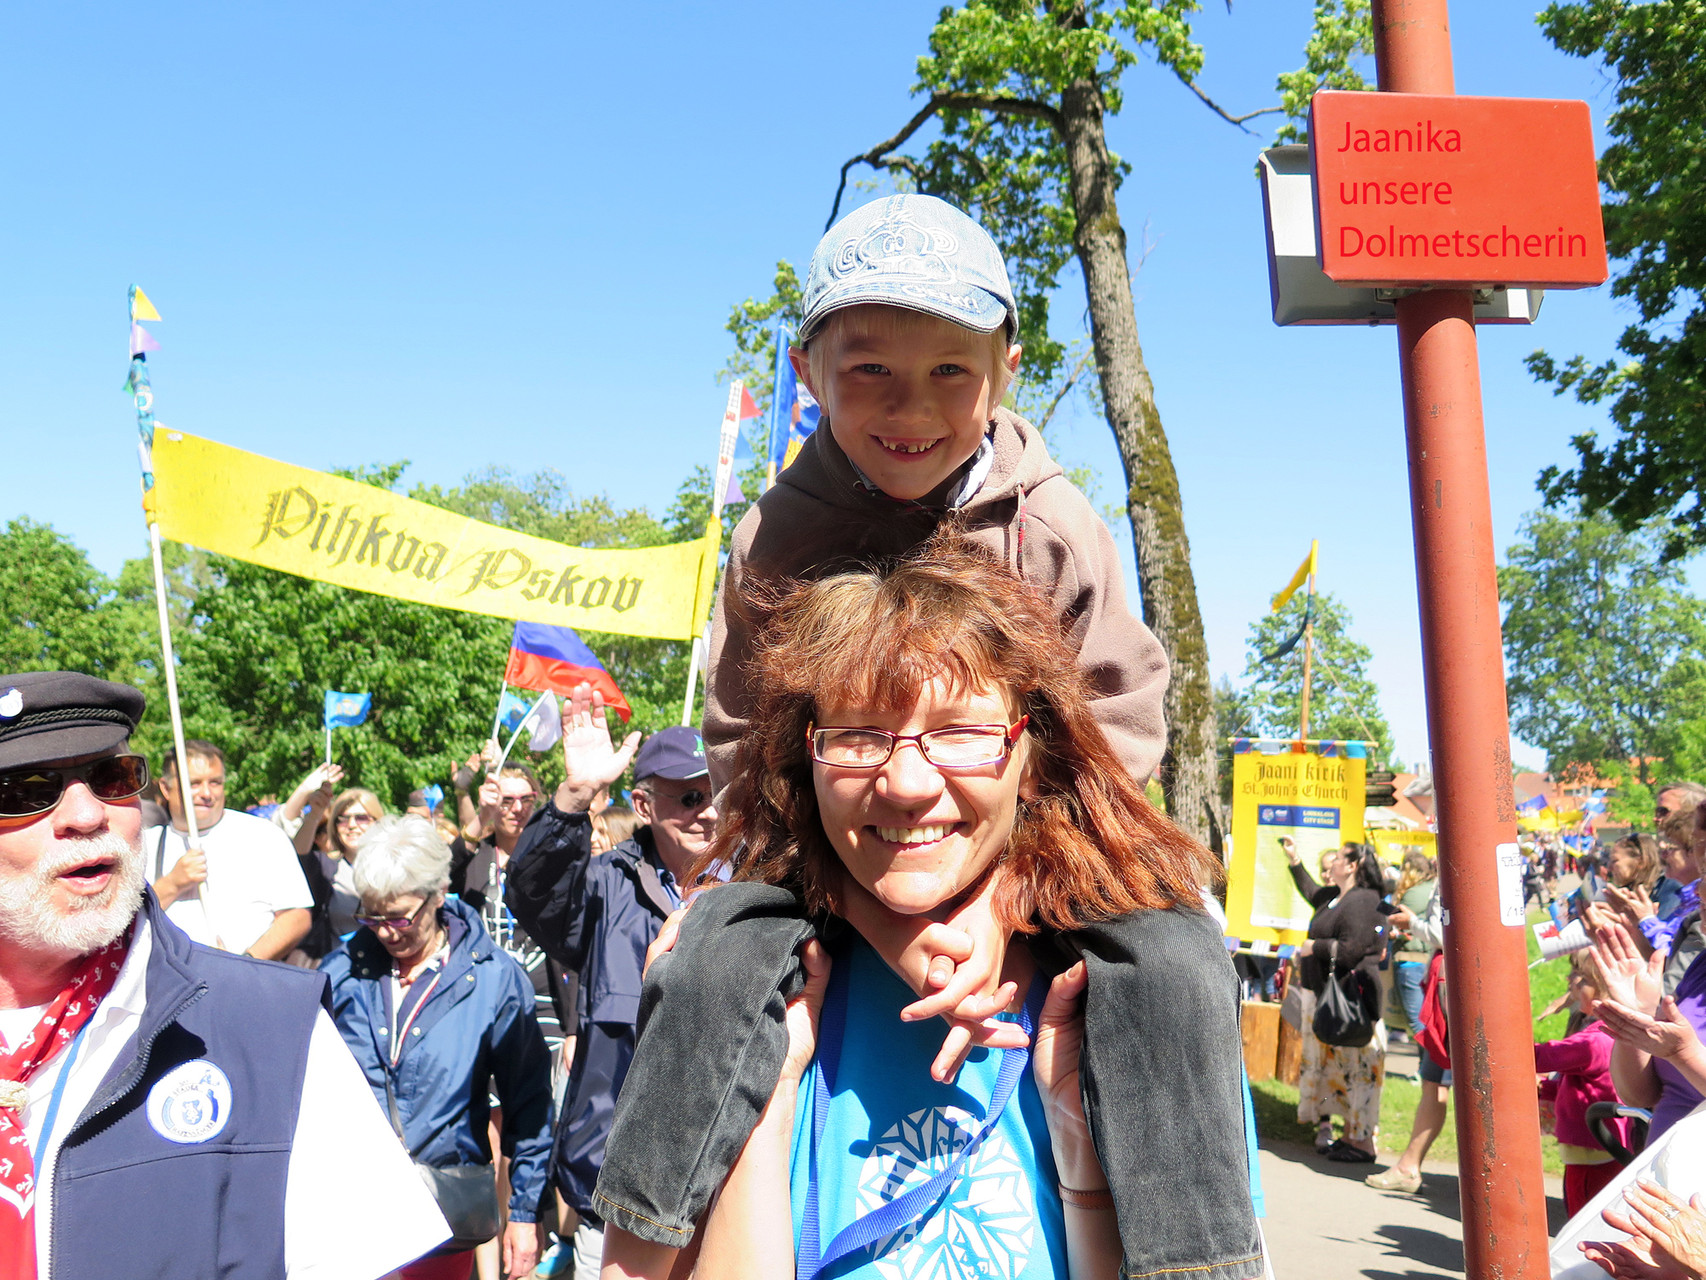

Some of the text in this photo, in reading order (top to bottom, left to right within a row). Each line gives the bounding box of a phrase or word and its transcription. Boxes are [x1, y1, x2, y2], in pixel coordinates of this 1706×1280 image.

[1254, 761, 1346, 783] Jaani kirik
[1242, 781, 1348, 801] St. John's Church
